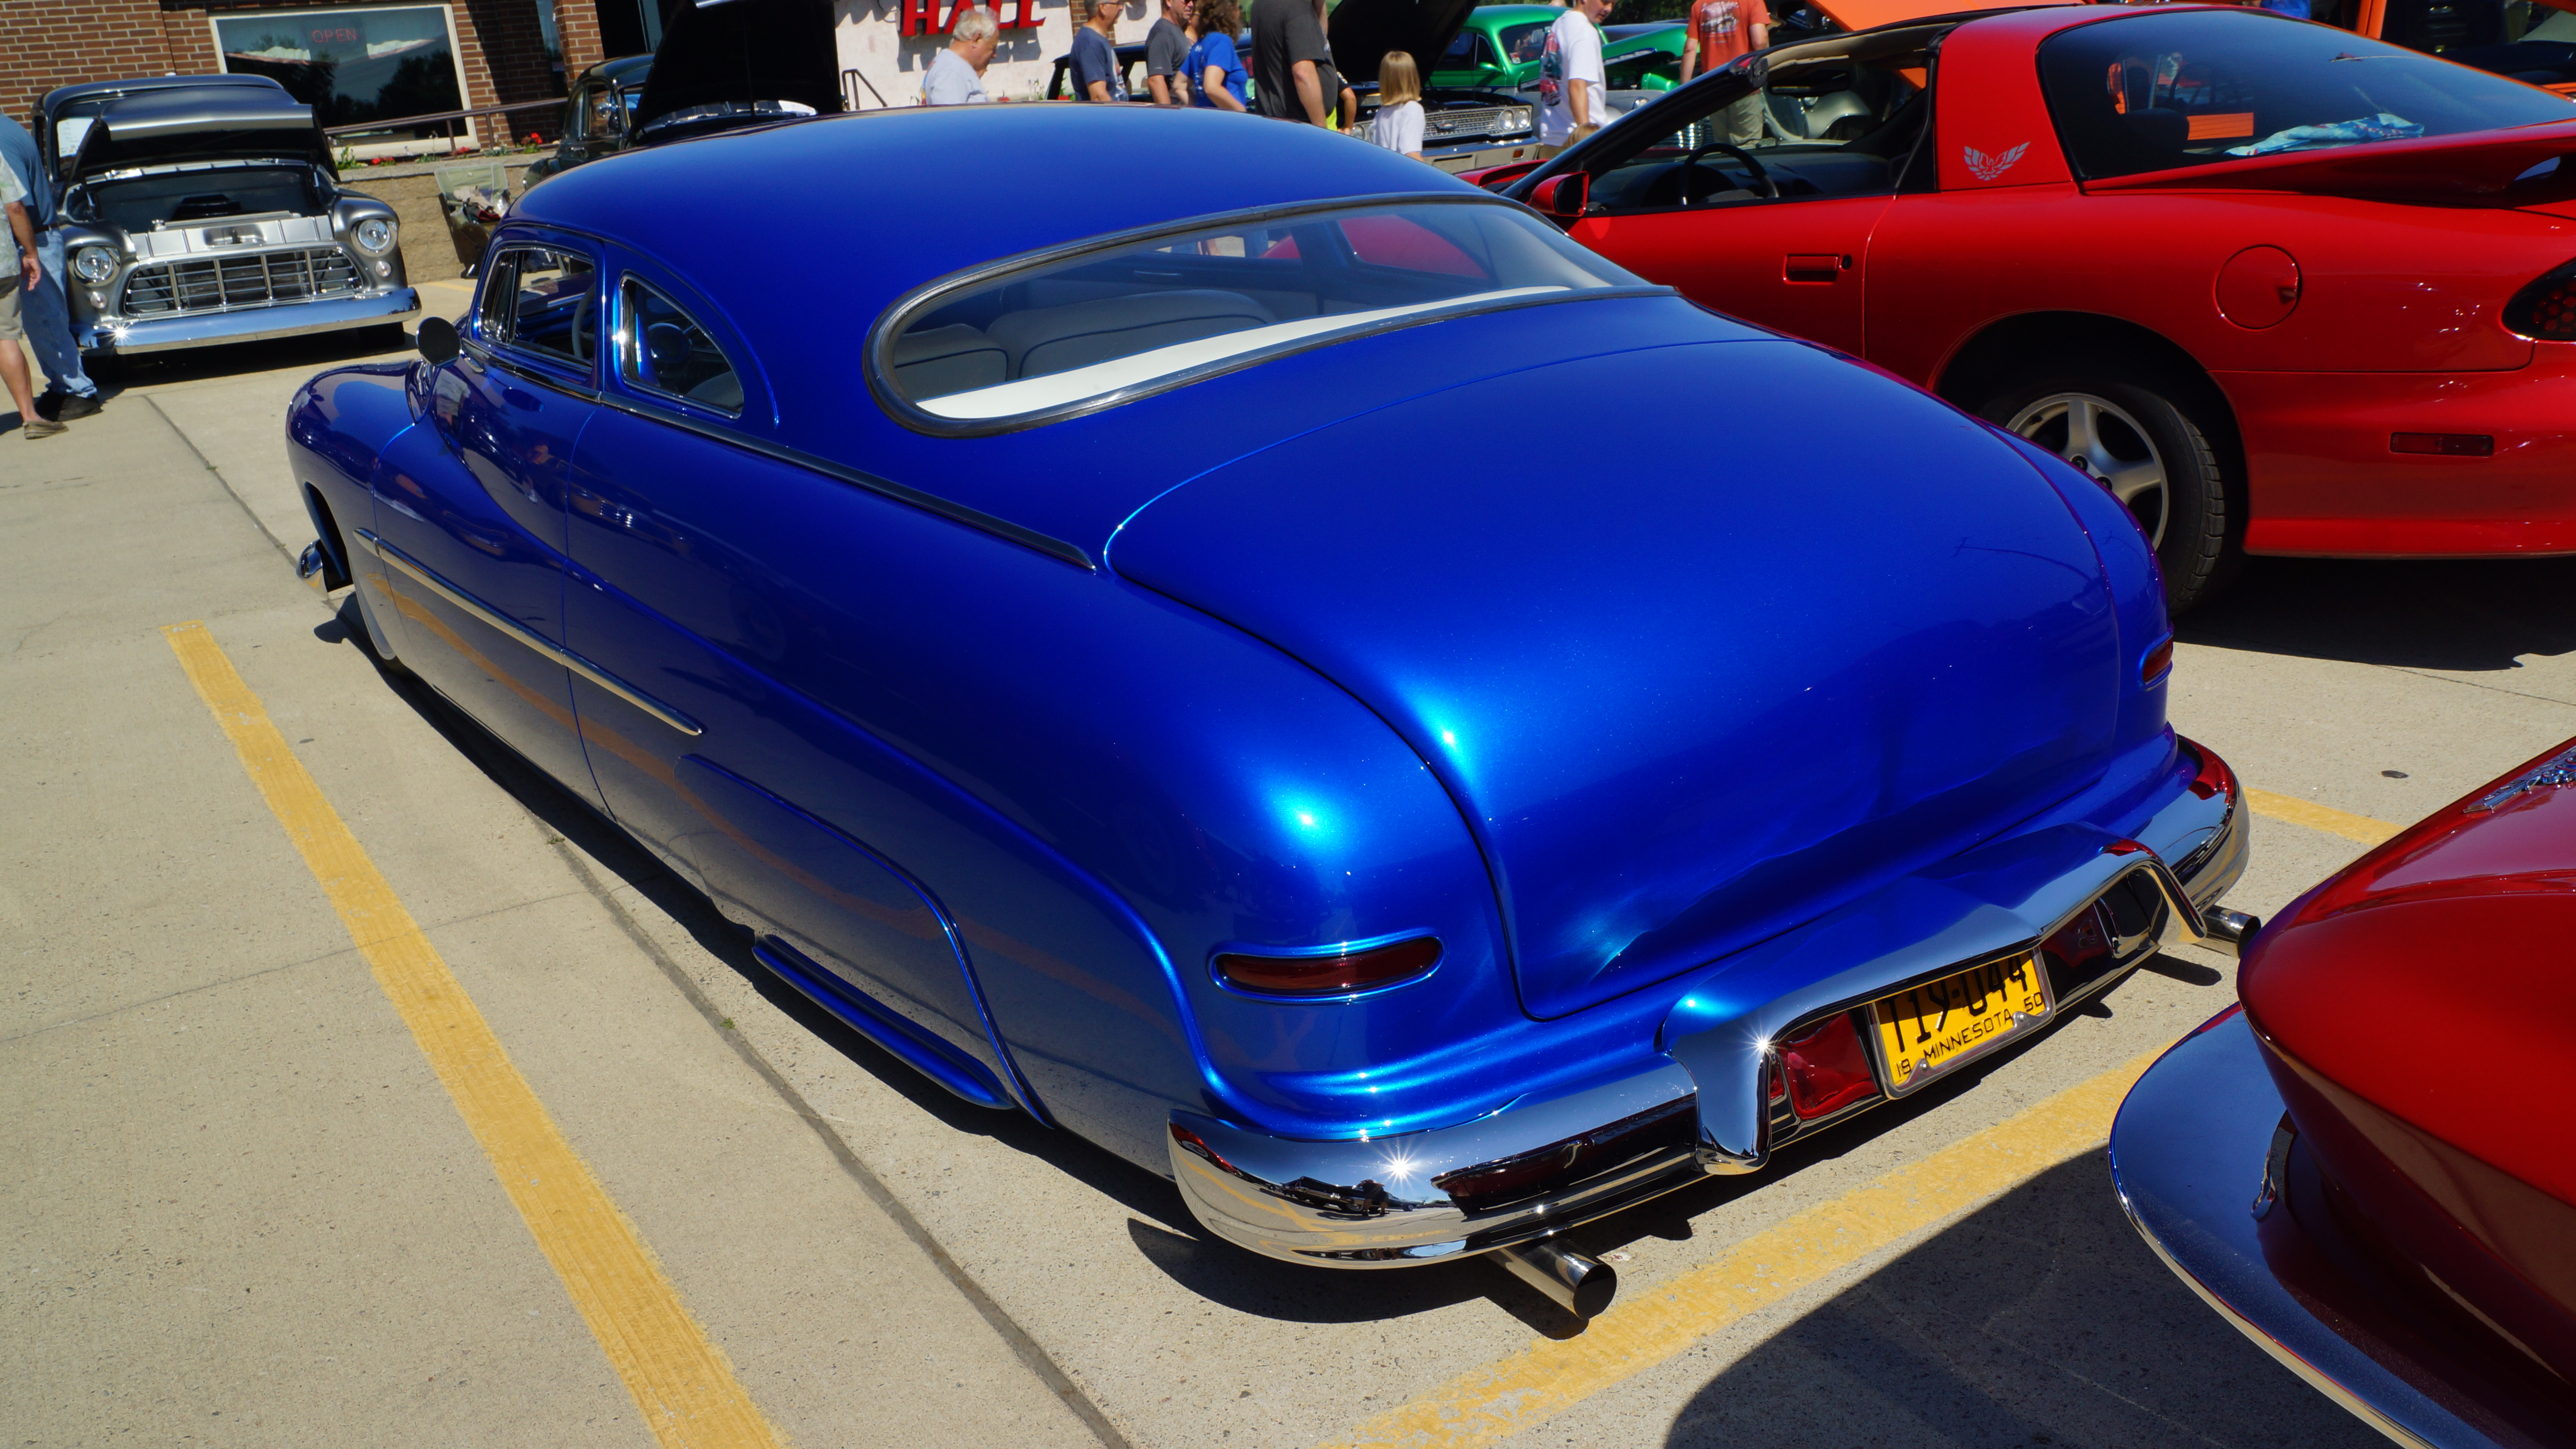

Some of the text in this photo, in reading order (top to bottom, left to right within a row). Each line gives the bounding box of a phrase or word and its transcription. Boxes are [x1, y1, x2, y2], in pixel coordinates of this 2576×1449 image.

[312, 28, 357, 42] OPEN
[1895, 991, 2043, 1077] 19 MINNESOTA 50
